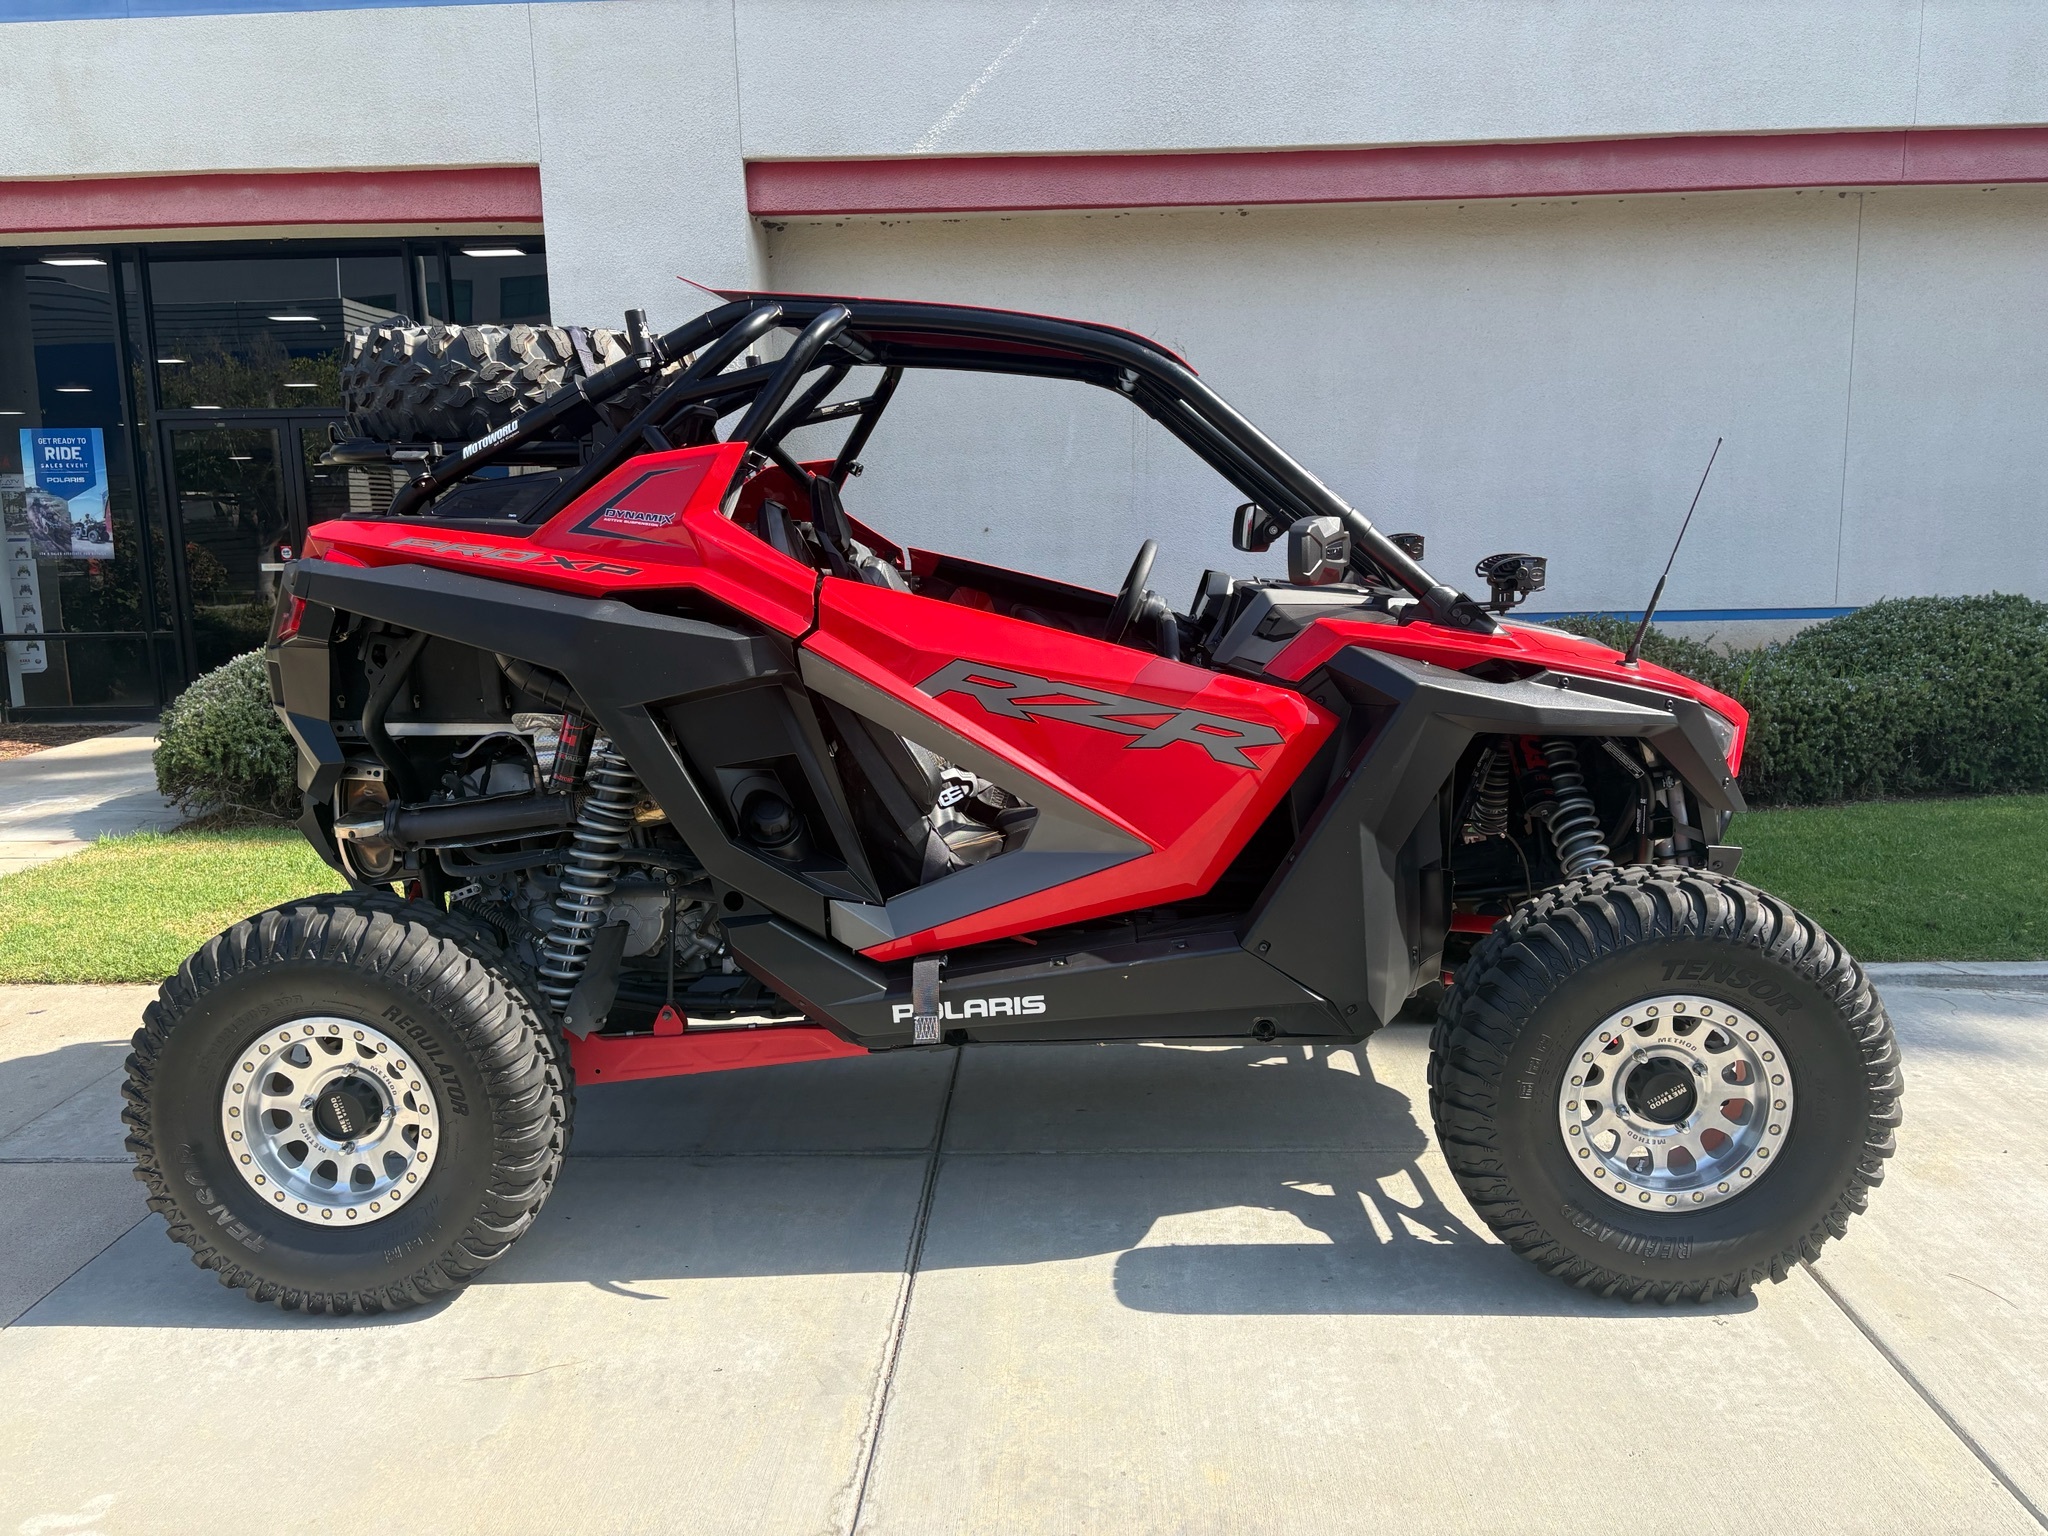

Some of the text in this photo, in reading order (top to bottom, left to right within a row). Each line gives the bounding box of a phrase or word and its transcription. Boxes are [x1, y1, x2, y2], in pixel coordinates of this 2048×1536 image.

[44, 446, 82, 461] RIDE
[463, 419, 519, 460] MOTOWORLD
[604, 508, 677, 527] DYNAMIX
[386, 537, 645, 577] PRO XP
[912, 657, 1288, 771] RZR
[1660, 959, 1803, 1017] TENSOR
[891, 994, 1047, 1024] PLARIS
[1657, 1037, 1698, 1052] METHOD
[381, 1004, 470, 1117] REGULATOR
[370, 1065, 398, 1096] METHOD
[1649, 1086, 1688, 1110] METHOD
[330, 1097, 349, 1133] METHOD
[299, 1122, 327, 1154] METHOD
[1626, 1130, 1667, 1145] METHOD
